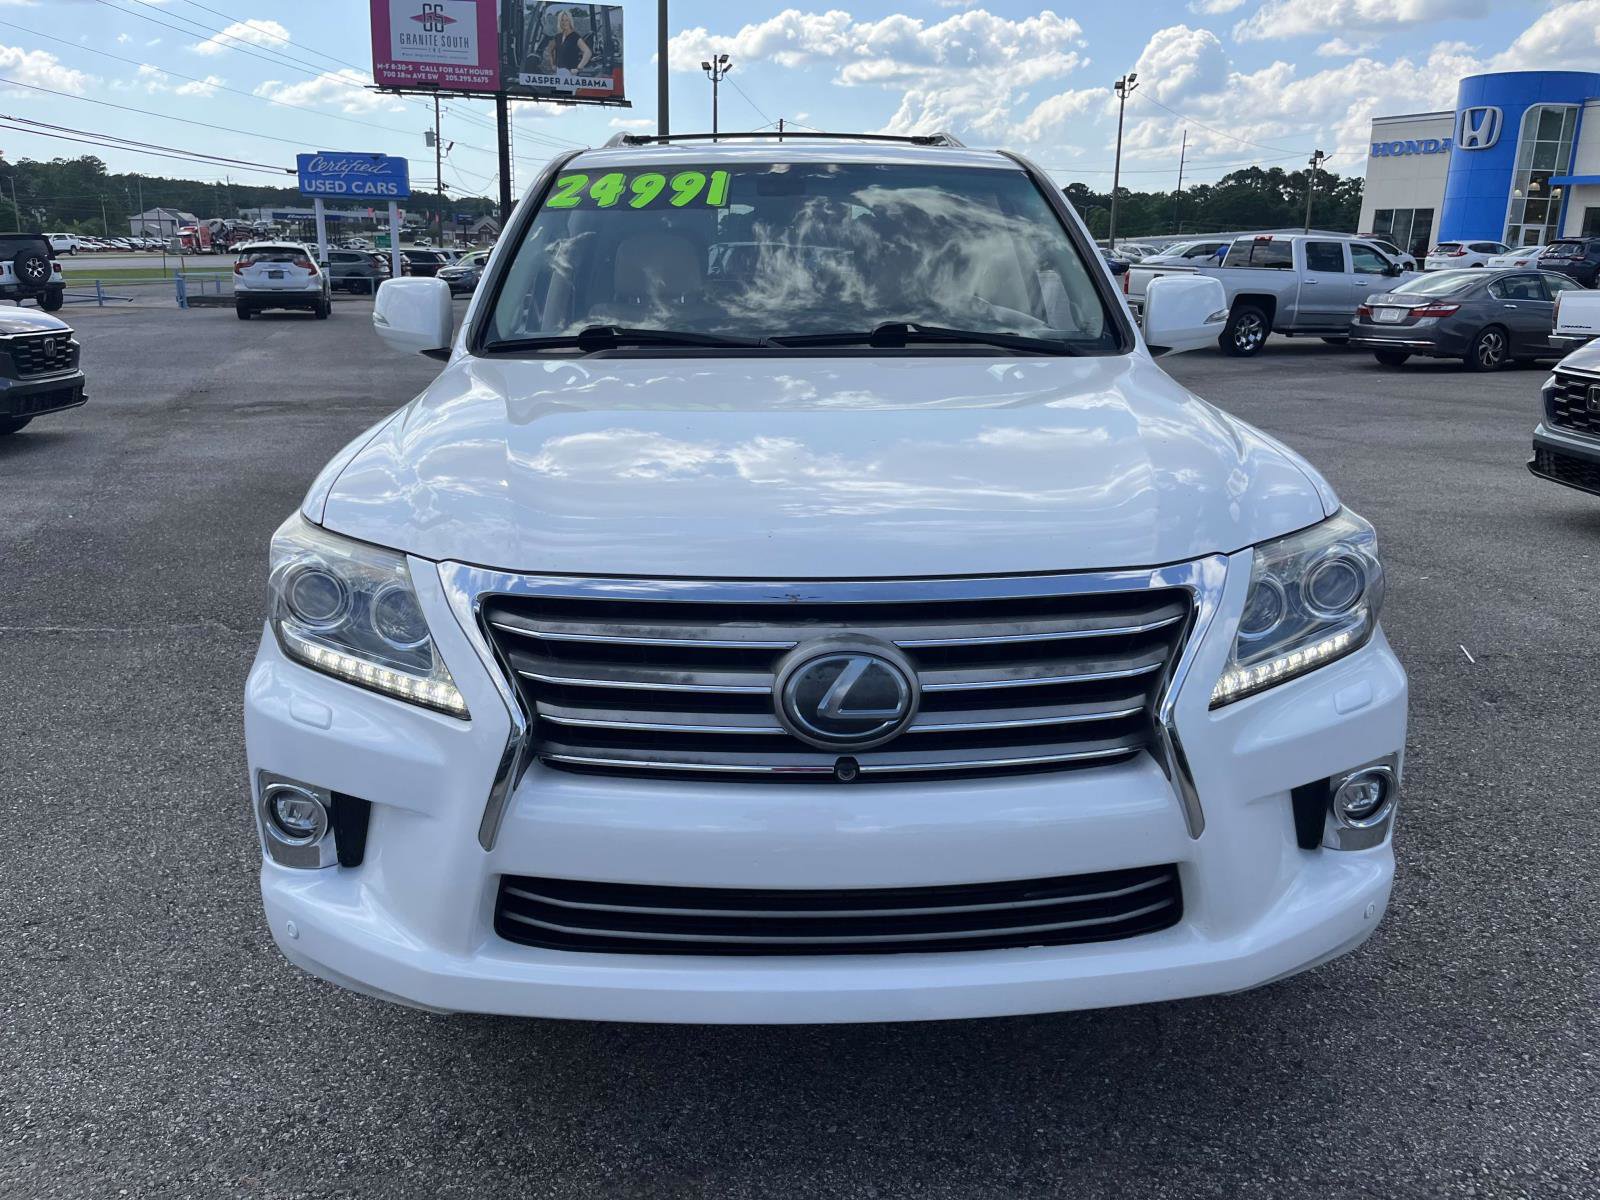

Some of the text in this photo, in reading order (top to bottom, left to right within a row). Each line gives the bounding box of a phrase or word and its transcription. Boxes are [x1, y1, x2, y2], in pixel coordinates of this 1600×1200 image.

[399, 33, 470, 49] GRANITE SOUTH
[420, 65, 438, 73] CALL
[439, 66, 454, 74] FOR
[455, 67, 468, 75] SAT
[469, 68, 494, 76] HOURS
[525, 75, 608, 88] JASPER ALABAMA
[308, 156, 392, 178] Certified
[304, 179, 398, 195] USED CARS
[546, 170, 731, 208] 24991
